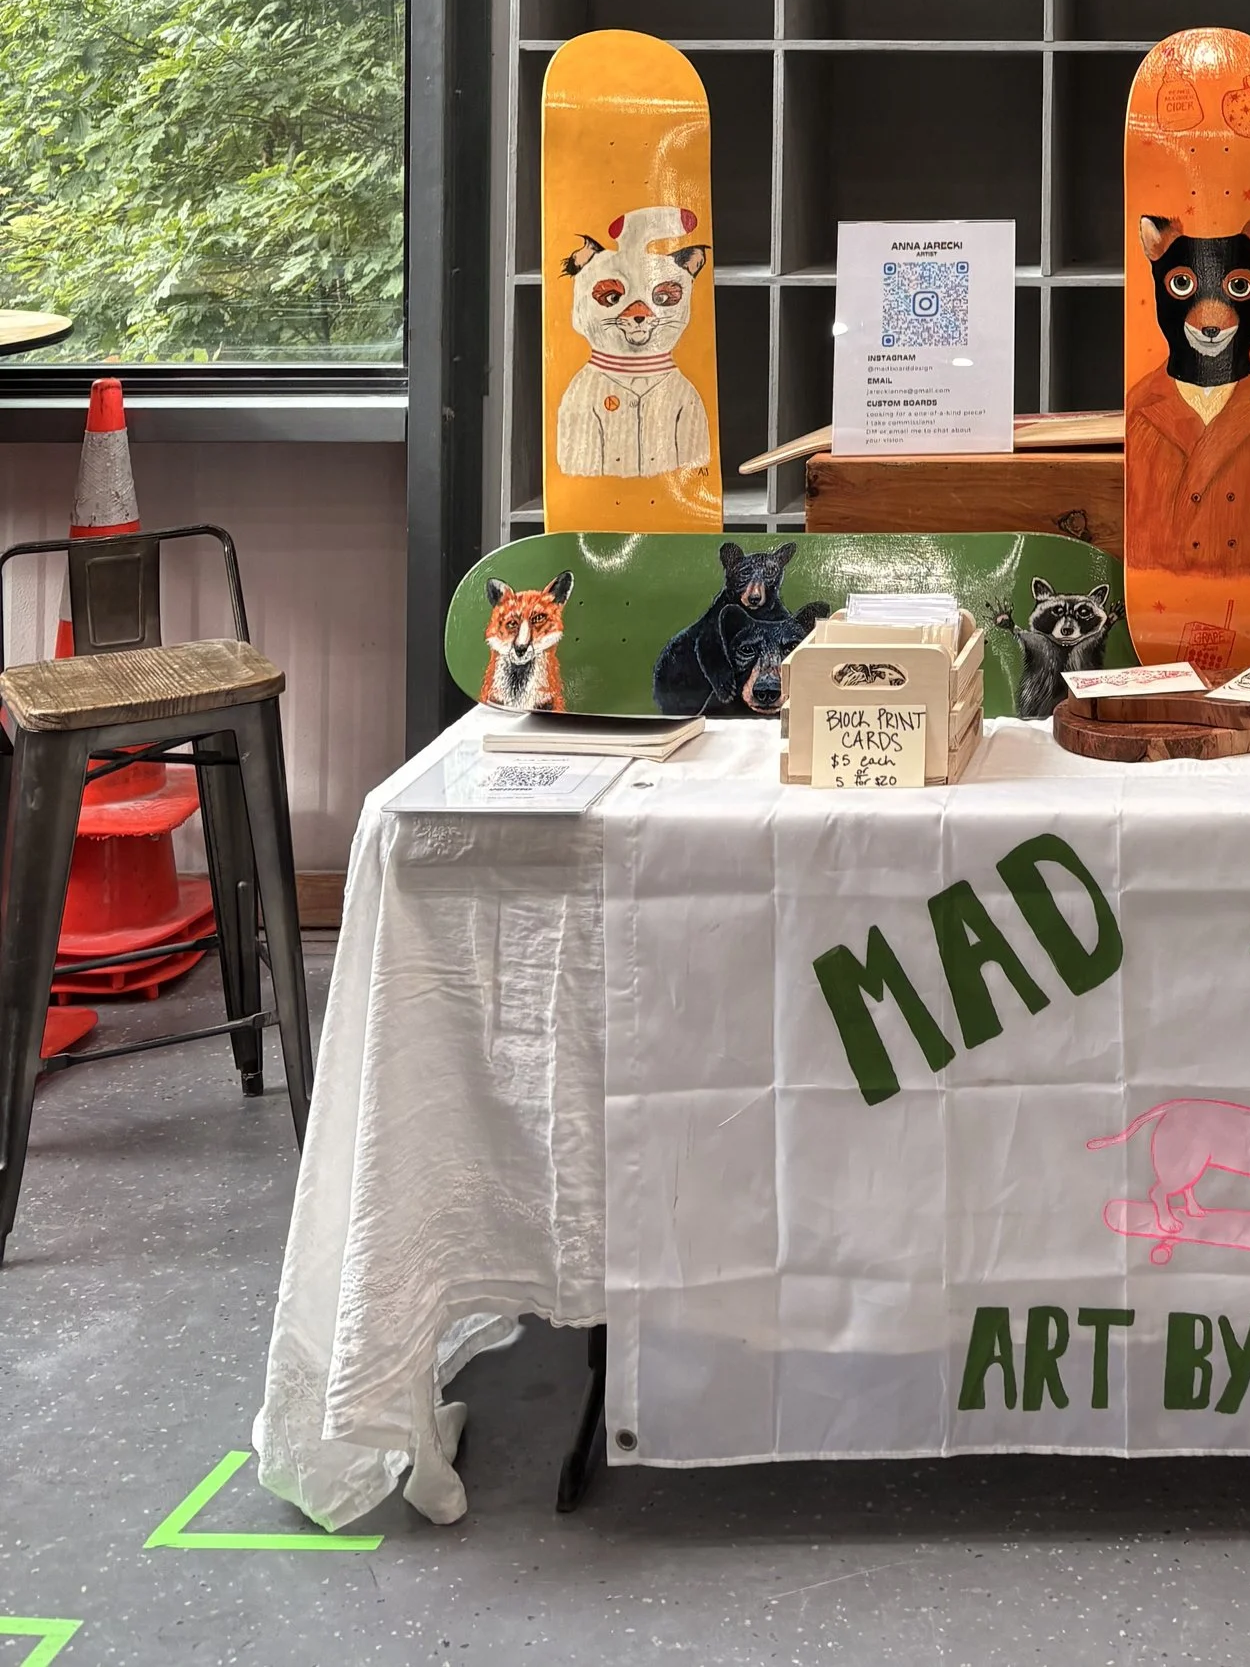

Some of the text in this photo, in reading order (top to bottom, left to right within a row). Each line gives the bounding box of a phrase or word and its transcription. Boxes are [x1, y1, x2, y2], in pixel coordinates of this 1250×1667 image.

[1166, 101, 1195, 113] CIDER
[891, 241, 963, 251] ANNA JARECKI
[867, 354, 916, 362] INSTAGRAM
[1193, 630, 1227, 643] GRAPE
[877, 707, 926, 731] PRINT
[841, 730, 903, 752] CARDS
[860, 755, 896, 767] each
[856, 767, 869, 775] or
[835, 776, 845, 788] 5
[875, 776, 897, 786] $20
[812, 833, 1124, 1105] MAD
[957, 1306, 1135, 1412] ART
